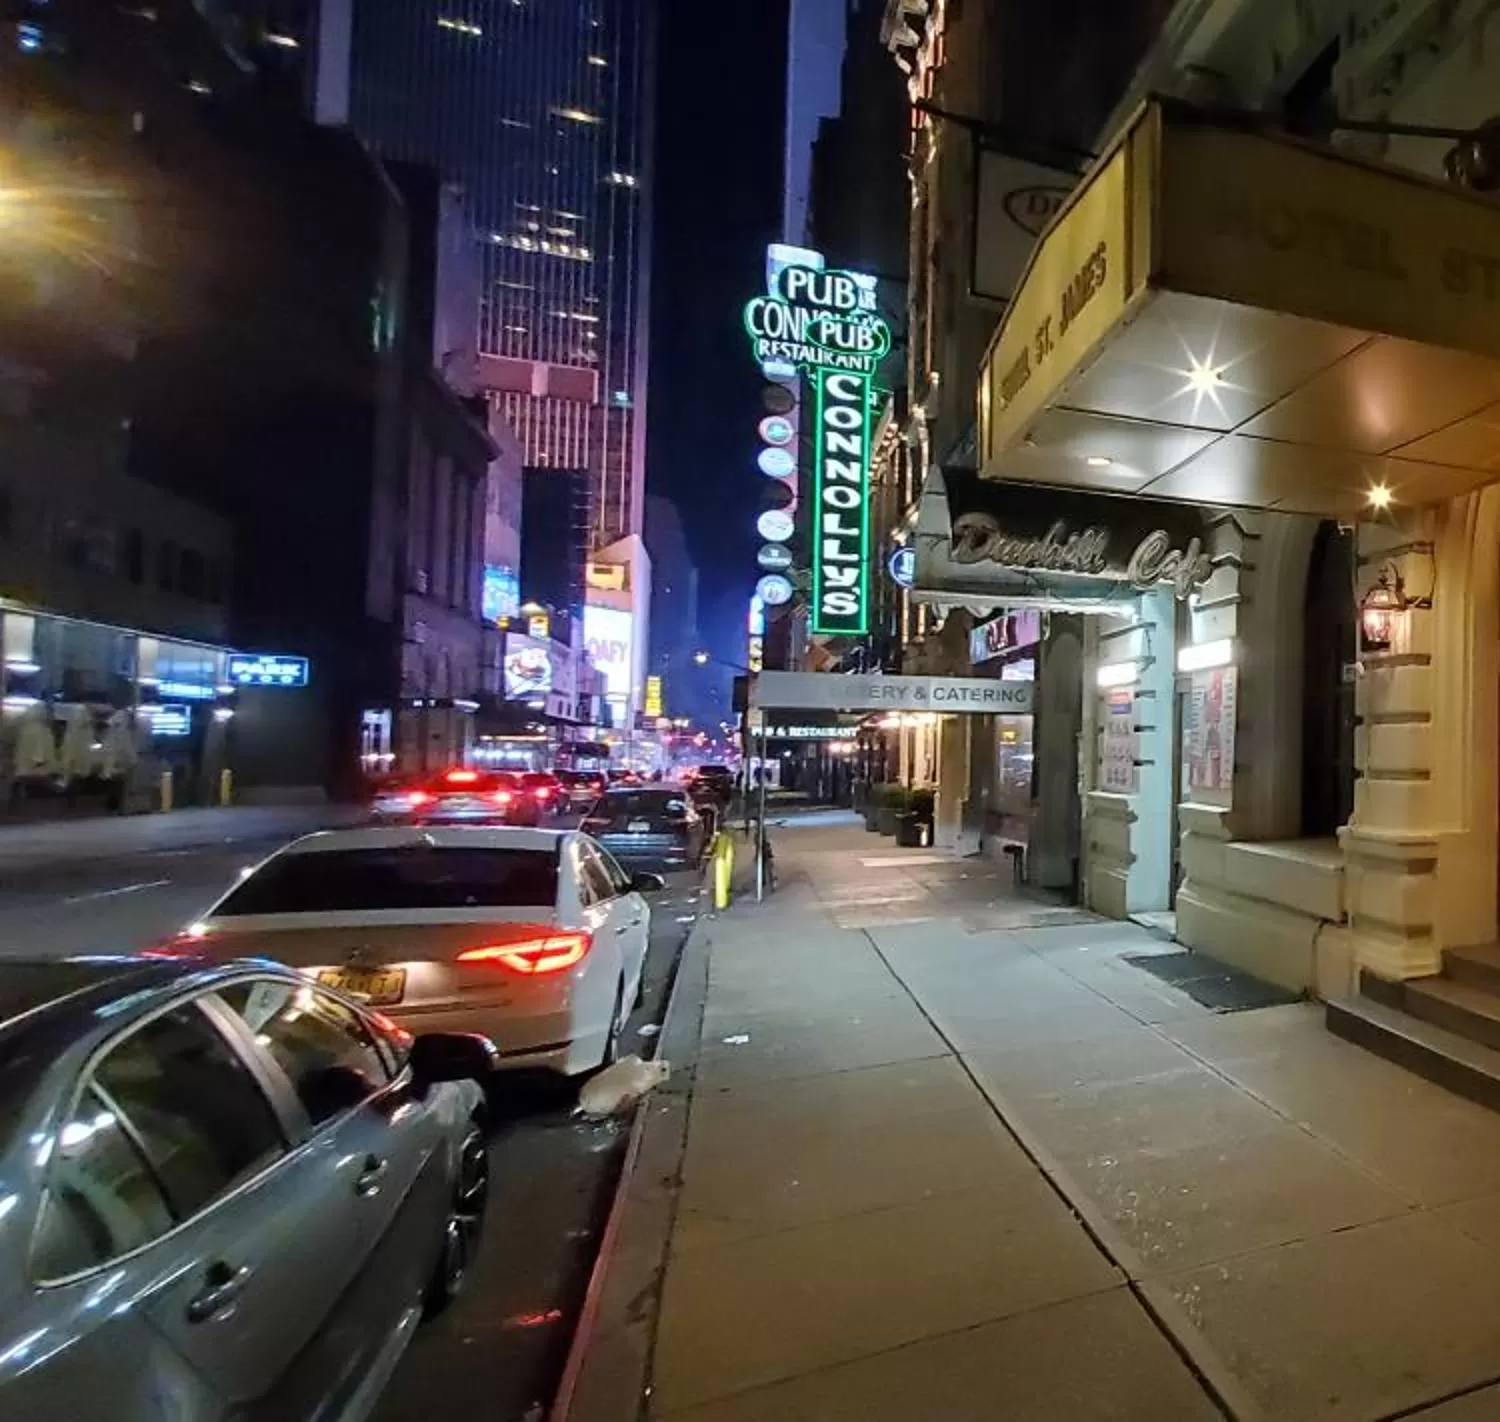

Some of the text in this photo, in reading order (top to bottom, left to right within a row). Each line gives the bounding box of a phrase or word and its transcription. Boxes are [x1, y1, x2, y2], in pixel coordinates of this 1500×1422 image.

[787, 267, 857, 309] PUB
[821, 320, 875, 350] PUB
[758, 338, 874, 371] RESTAURANT
[822, 374, 863, 616] CONNOLLY'S
[932, 686, 1028, 704] CATERING
